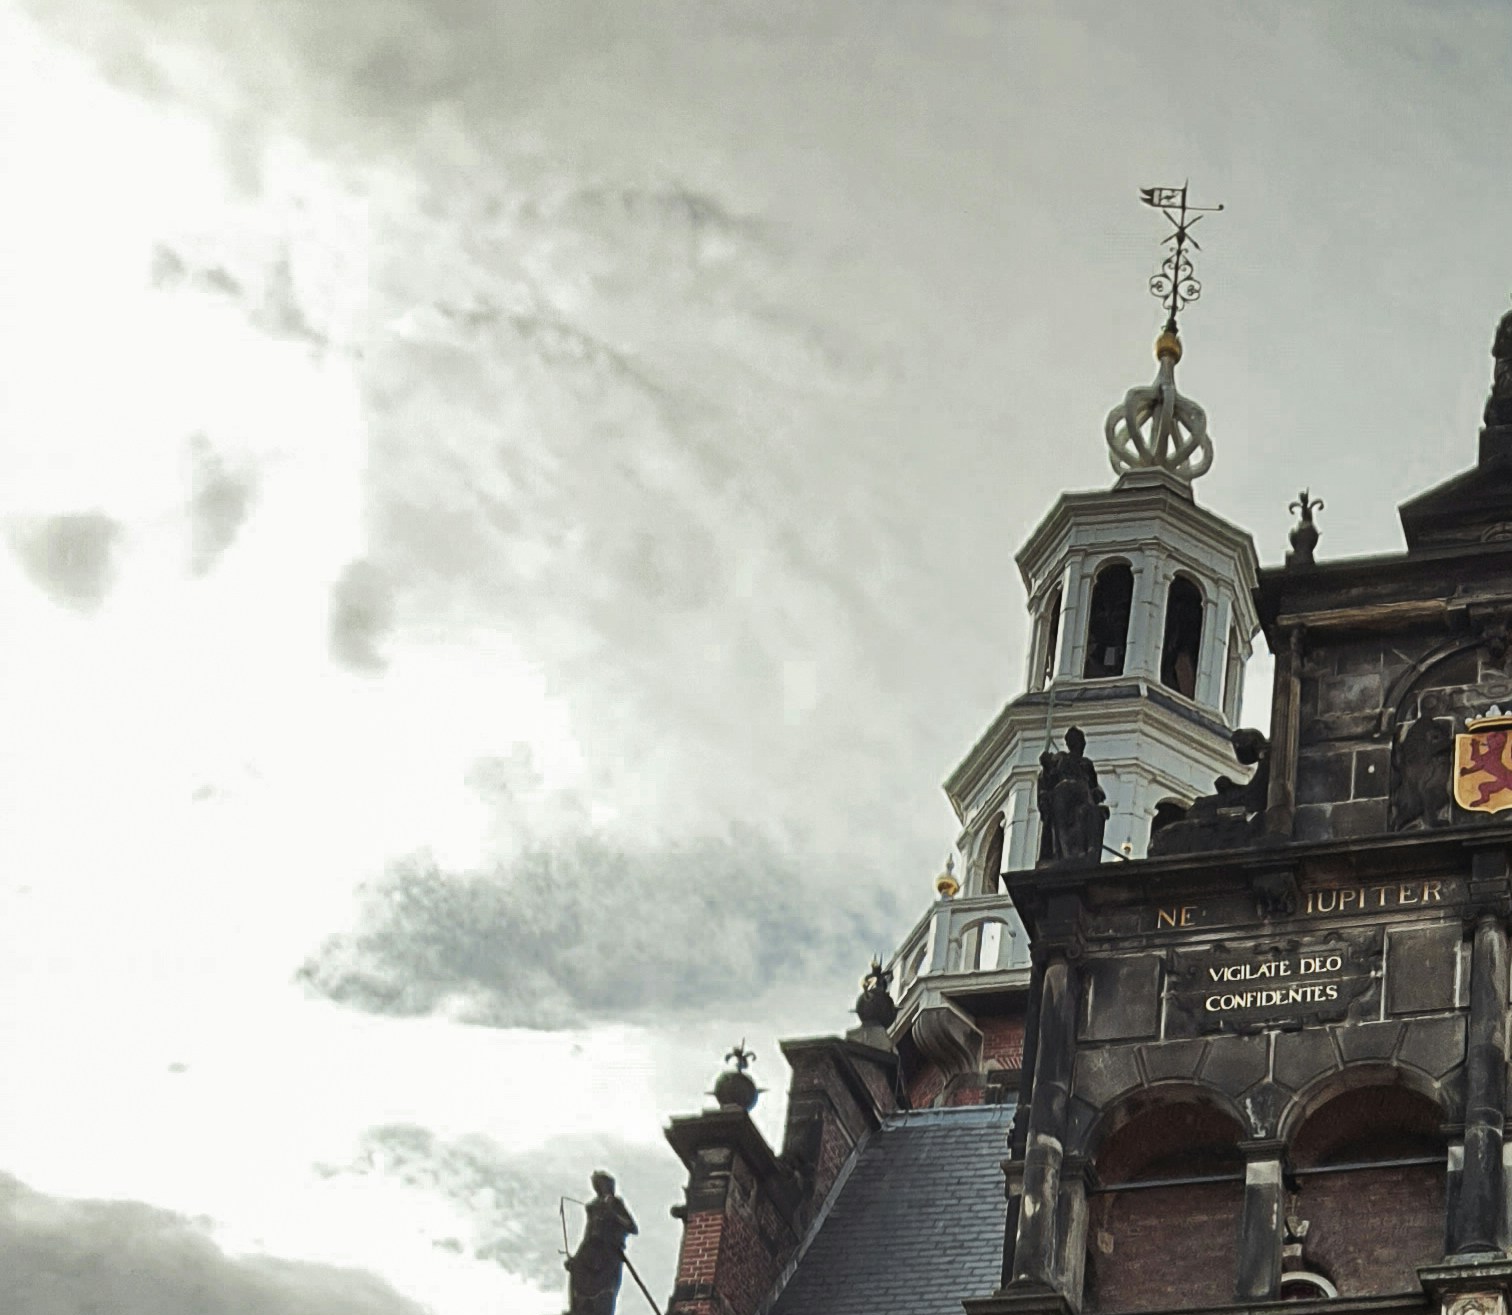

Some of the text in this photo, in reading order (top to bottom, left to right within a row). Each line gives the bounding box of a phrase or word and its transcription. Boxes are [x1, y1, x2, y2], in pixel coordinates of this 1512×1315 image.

[1306, 881, 1441, 914] IUPITER
[1209, 956, 1342, 982] VIGILATE DEO
[1205, 985, 1338, 1012] CONFIDENTES
